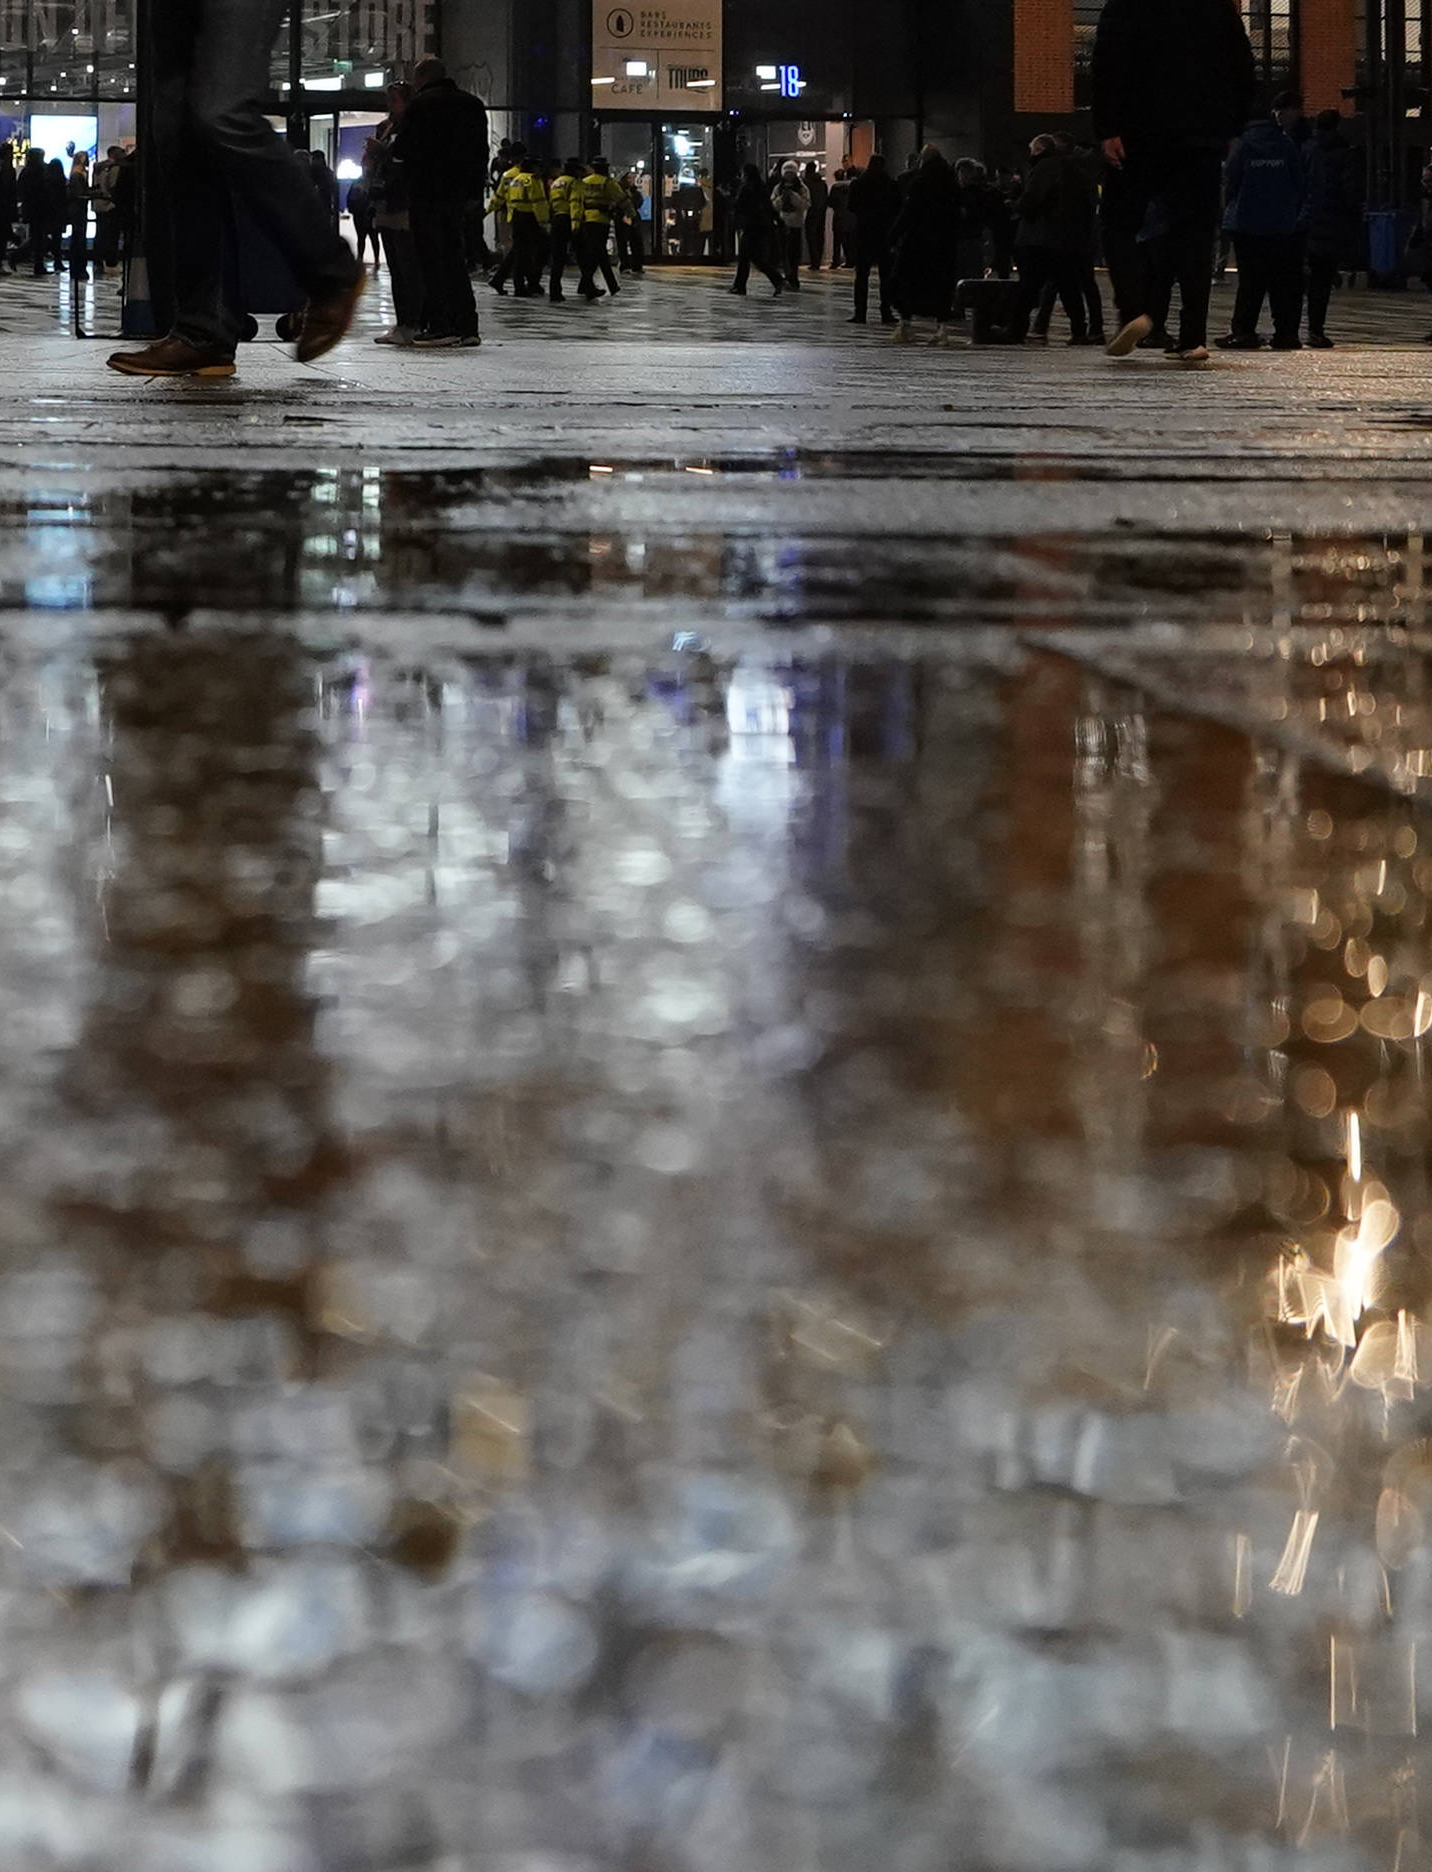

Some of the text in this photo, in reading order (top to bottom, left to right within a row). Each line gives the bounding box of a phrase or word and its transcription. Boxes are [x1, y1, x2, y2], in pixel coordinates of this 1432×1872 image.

[640, 11, 666, 21] BARS
[640, 21, 712, 30] RESTAURANTS
[640, 30, 712, 39] EXPERIENCES
[779, 65, 800, 97] 18
